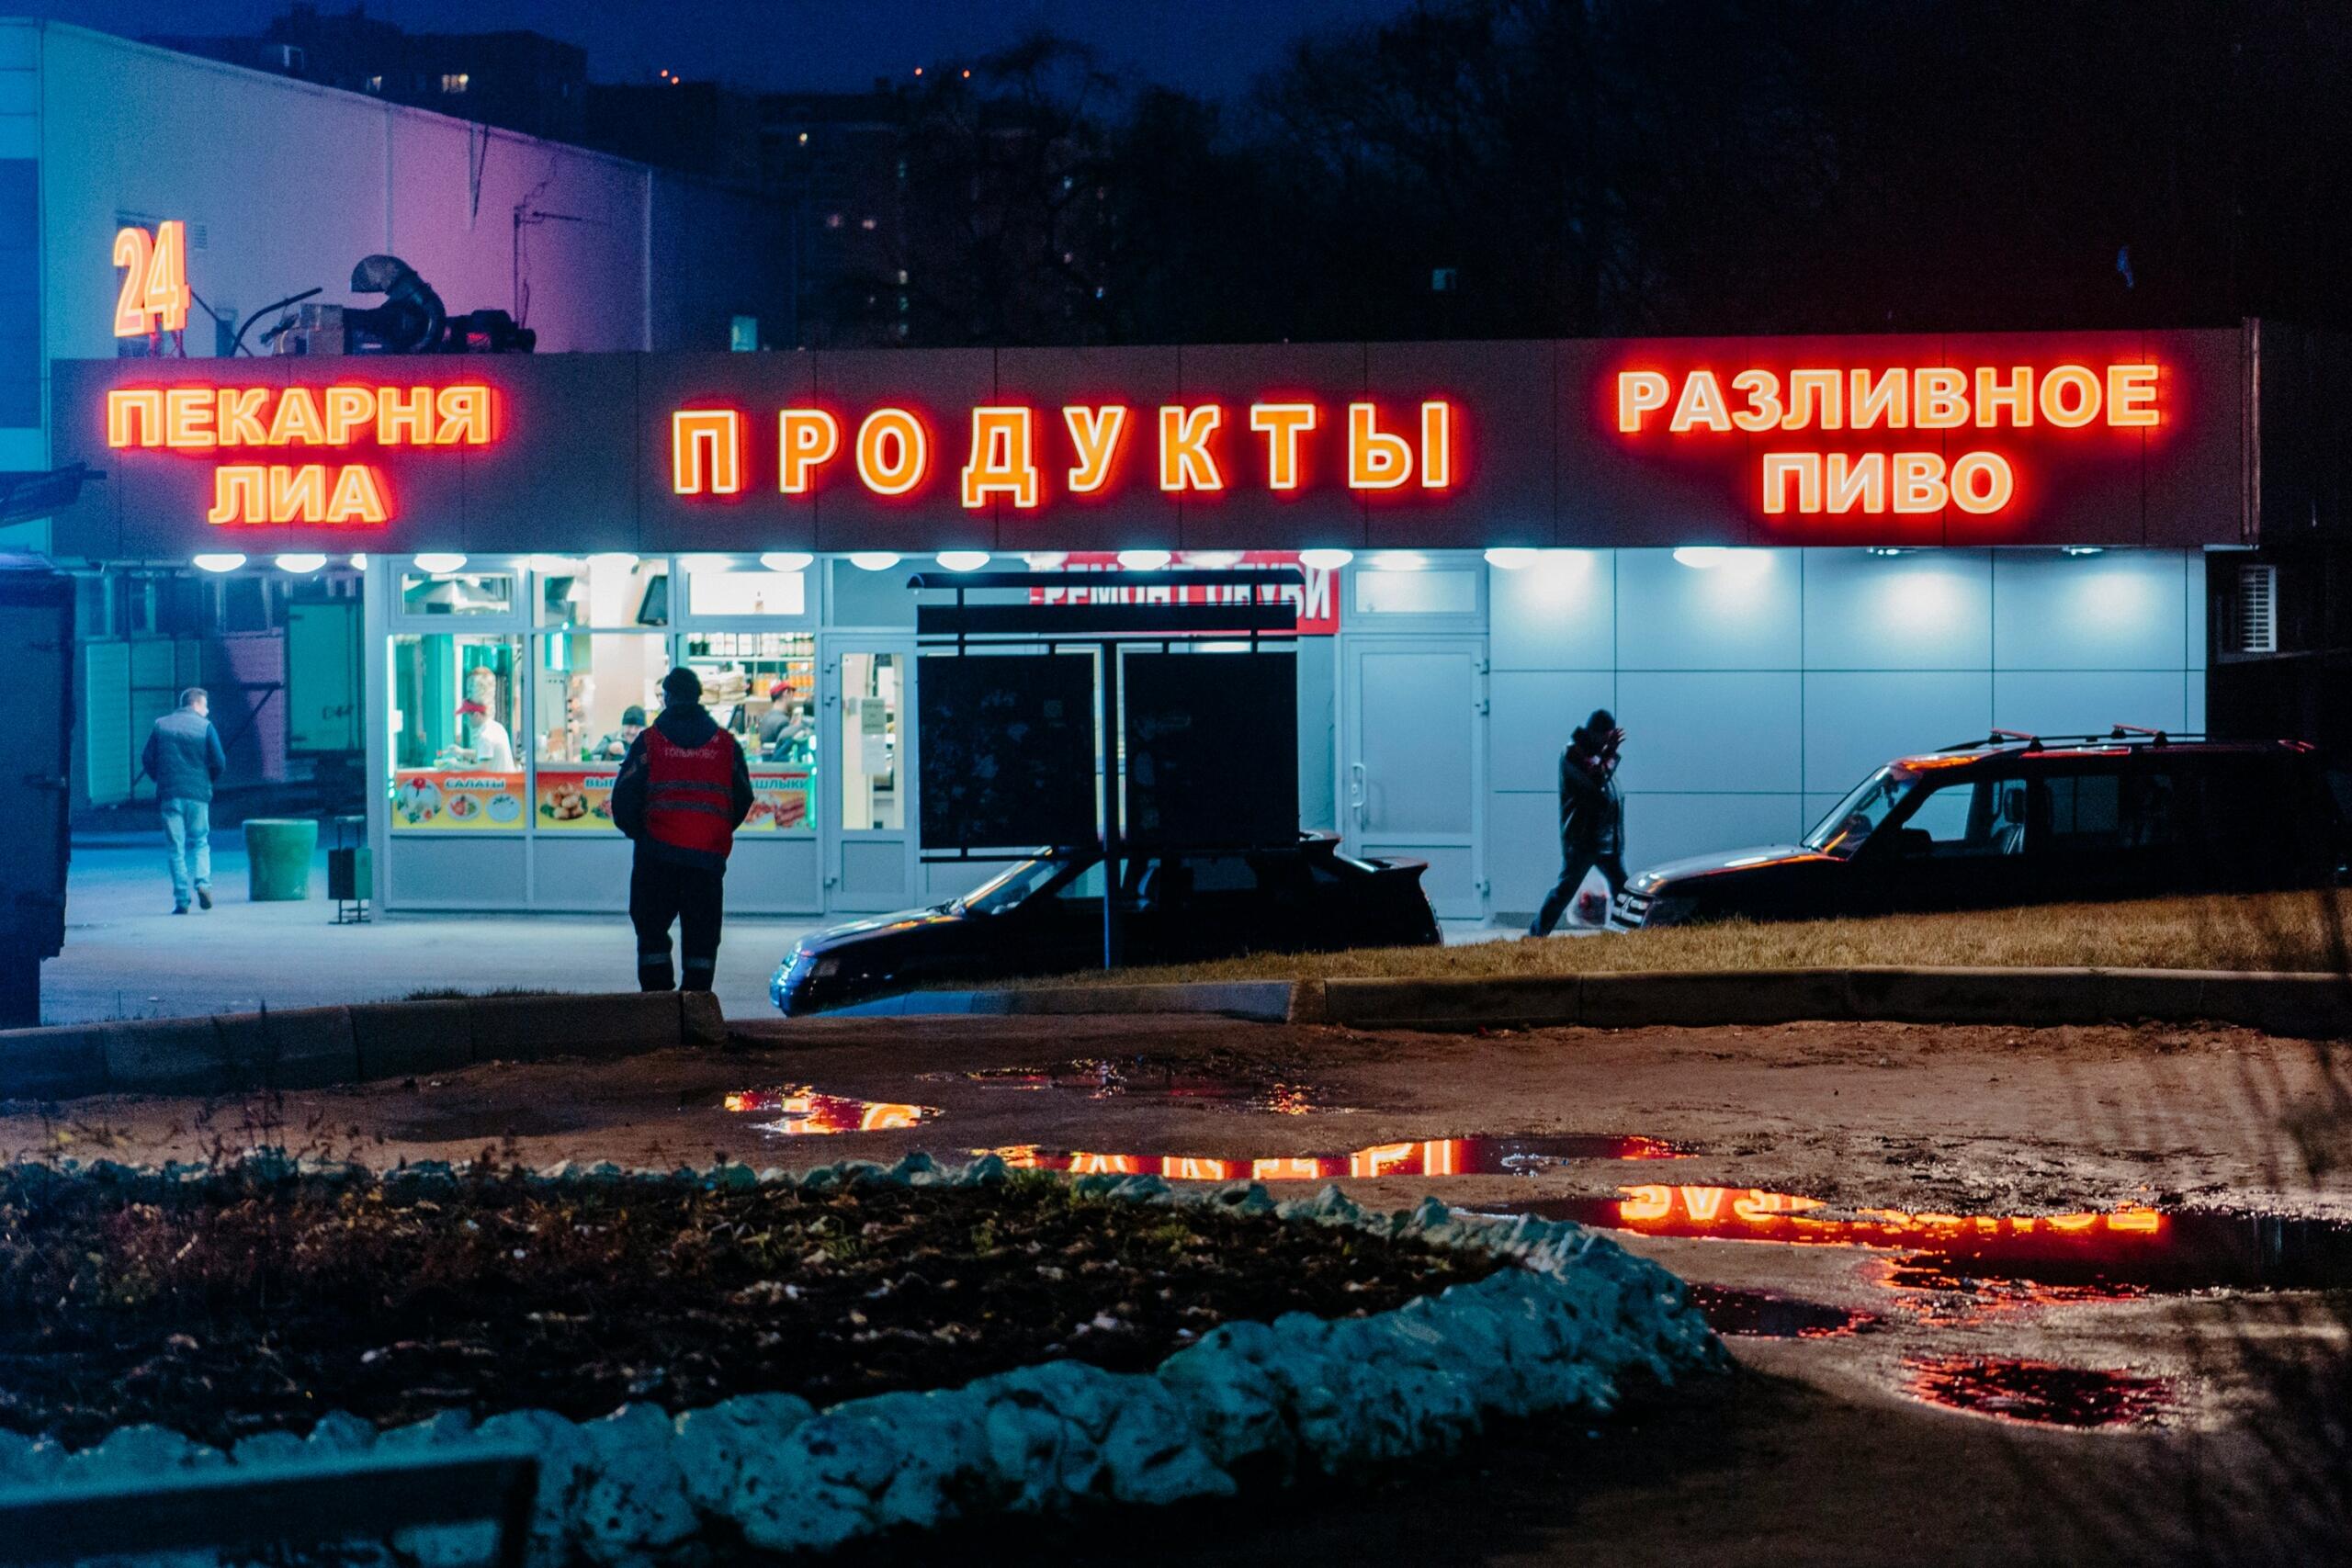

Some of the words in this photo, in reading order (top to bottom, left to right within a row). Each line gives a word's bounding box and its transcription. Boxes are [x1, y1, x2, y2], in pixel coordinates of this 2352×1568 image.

[113, 220, 190, 337] 24
[107, 386, 492, 448] ПЕКАРНЯ
[1617, 364, 2160, 434] РАЗЛИВНОЕ
[673, 401, 1452, 508] ПРОДУКТЫ
[1762, 451, 2014, 515] ПИВО
[208, 464, 388, 525] ЛИА
[445, 777, 506, 789] САЛАТЫ
